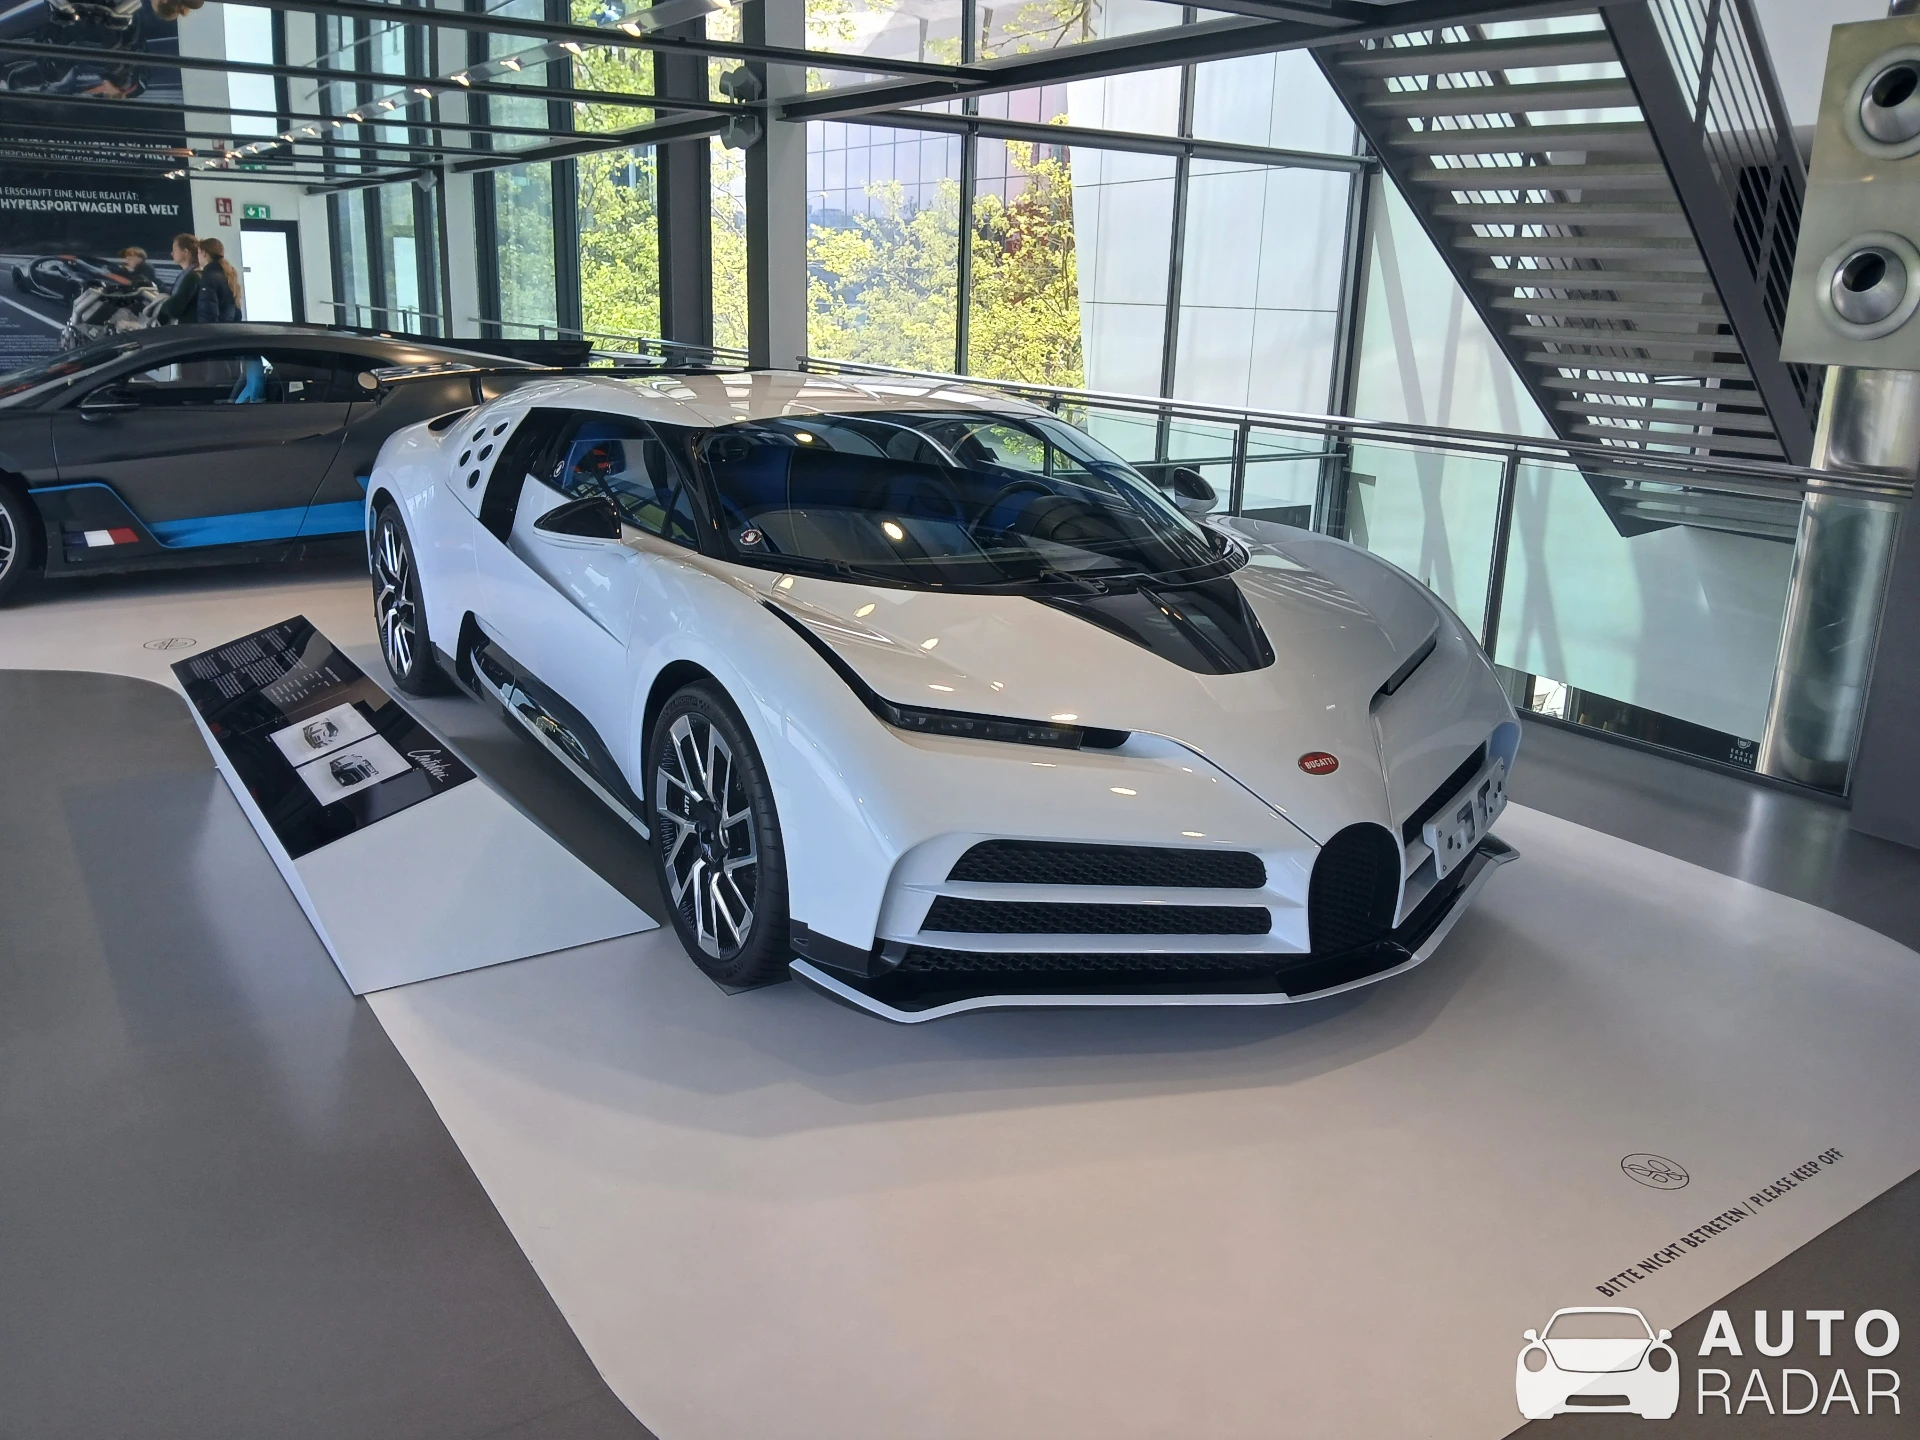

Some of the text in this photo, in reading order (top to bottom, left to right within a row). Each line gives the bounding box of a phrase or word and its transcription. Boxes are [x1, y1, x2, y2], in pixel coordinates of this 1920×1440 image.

[4, 186, 52, 197] ERSCHAFFT
[54, 189, 74, 198] EINE
[75, 190, 97, 199] NEUE
[99, 190, 140, 201] REALITÄT:
[1, 198, 179, 216] HYPERSPORTWAGEN DER WELT
[1304, 757, 1336, 769] BUGATTI
[1595, 1268, 1645, 1298] BITTE
[1637, 1242, 1687, 1273] NICHT
[1680, 1207, 1749, 1248] BETRETEN
[1749, 1176, 1798, 1207] PLEASE
[1789, 1161, 1822, 1182] KEEP
[1817, 1147, 1844, 1165] OFF
